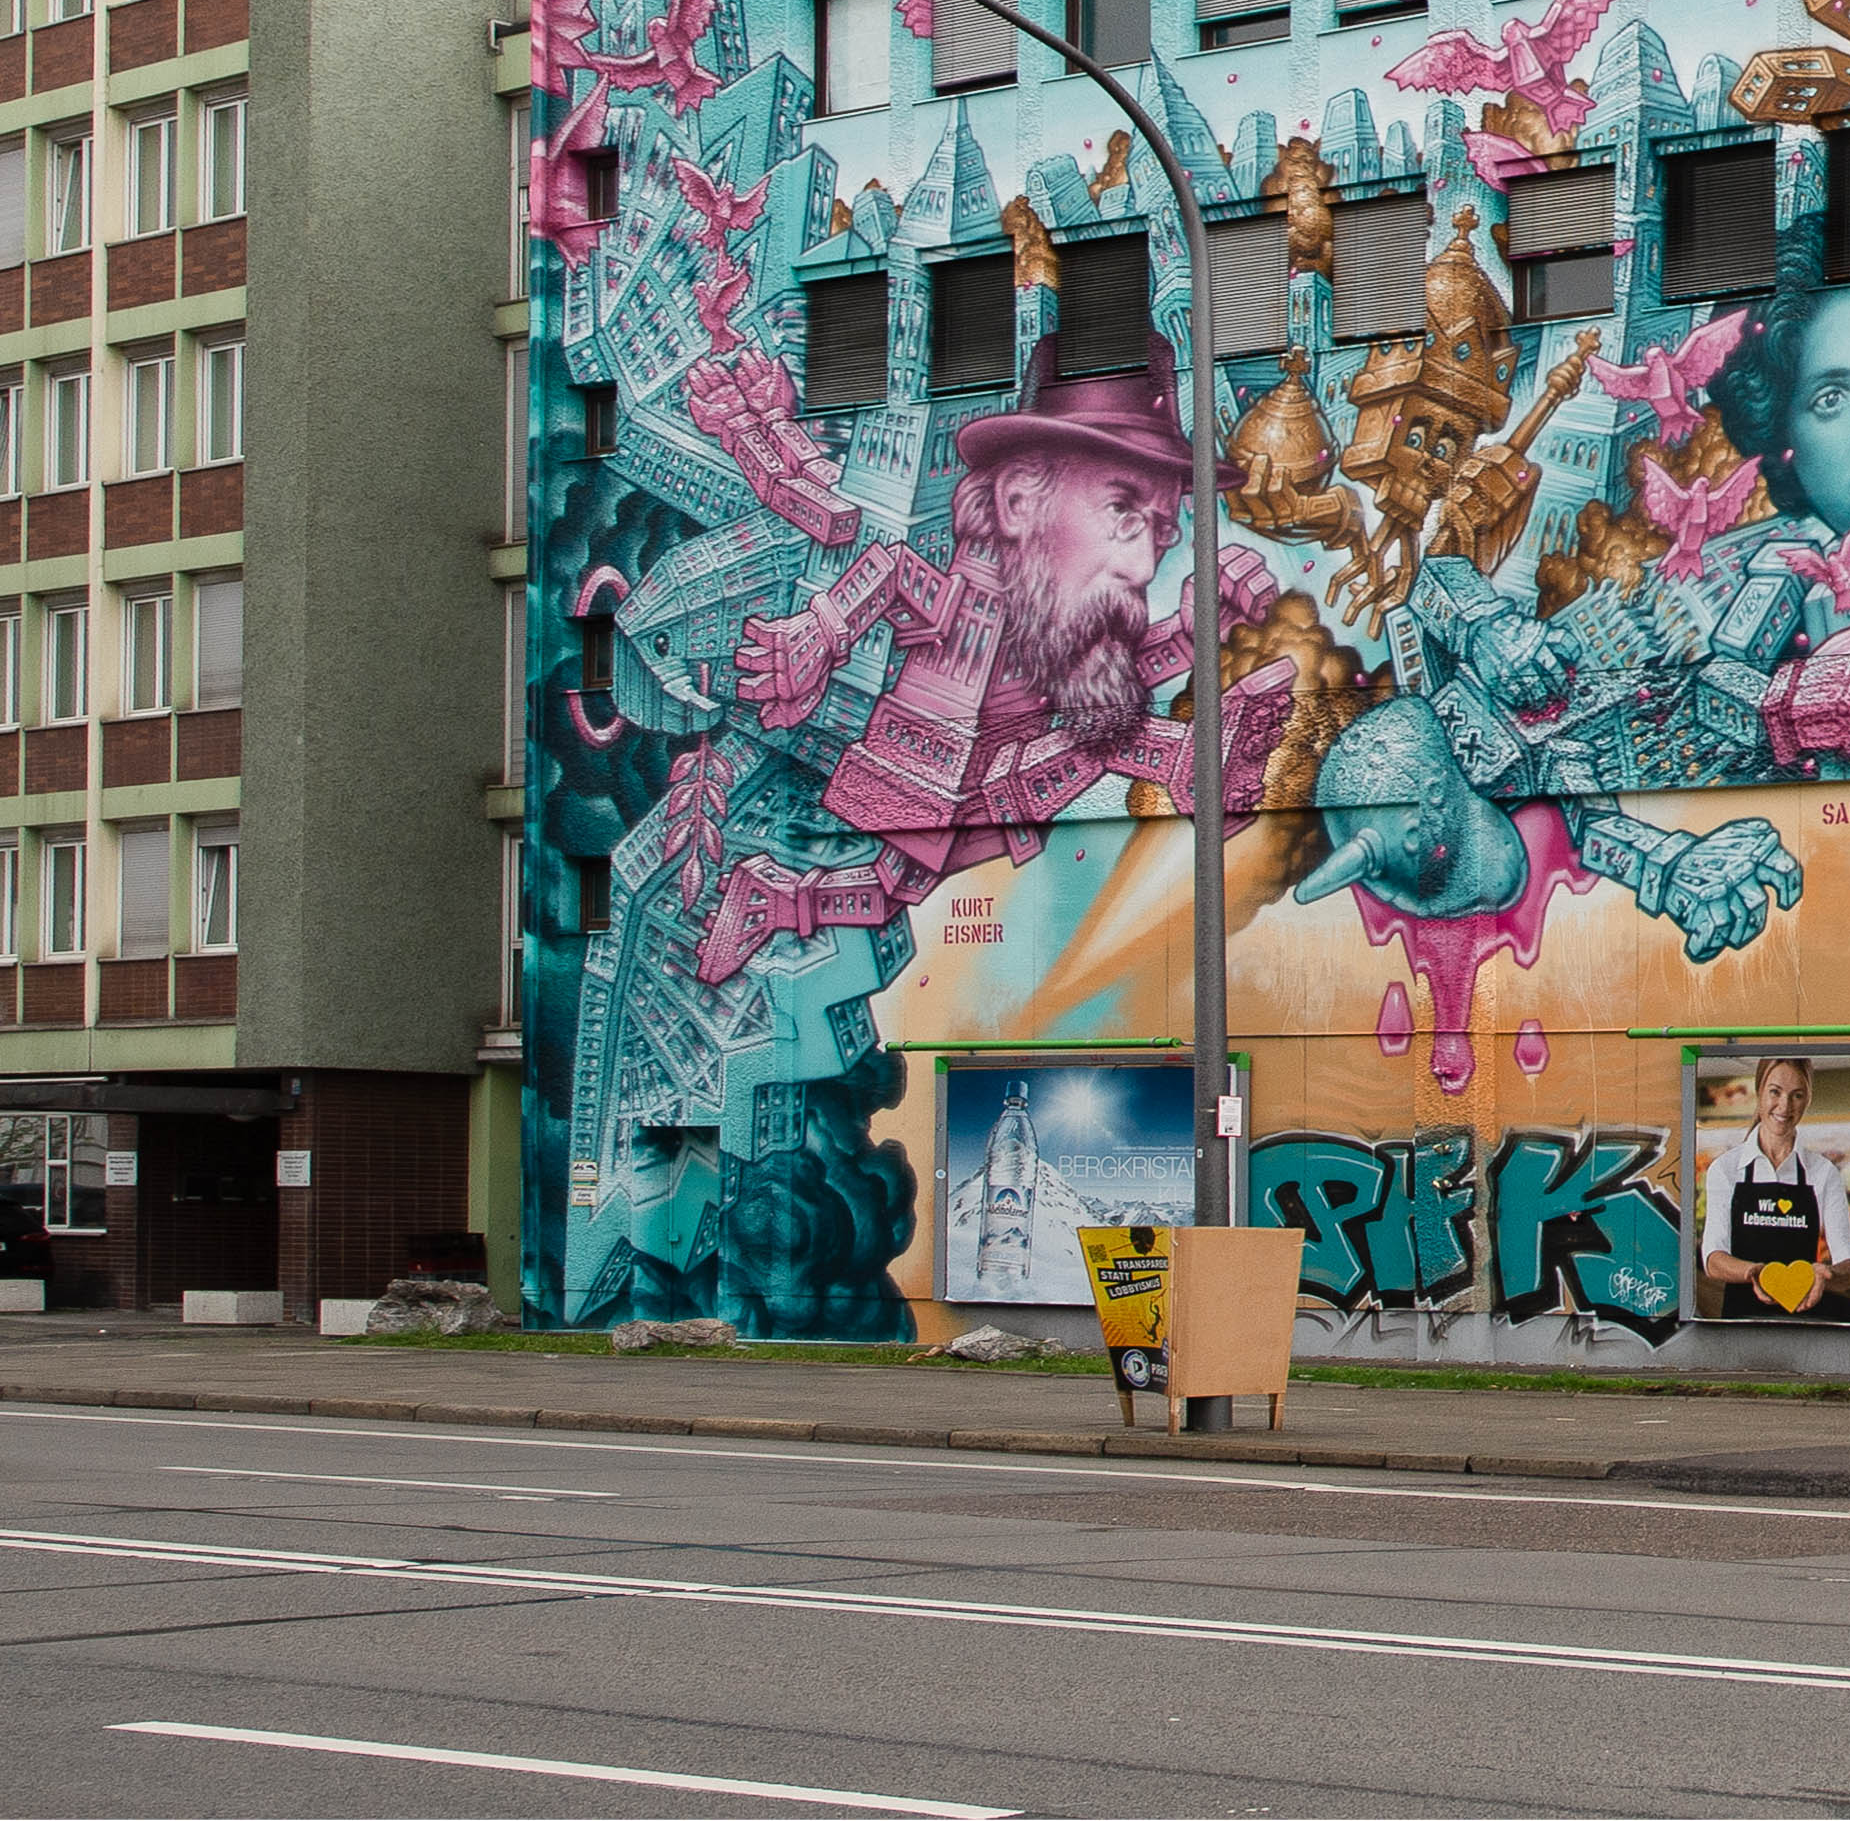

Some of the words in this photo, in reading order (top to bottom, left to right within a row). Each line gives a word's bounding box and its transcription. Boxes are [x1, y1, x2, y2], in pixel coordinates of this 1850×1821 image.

[951, 897, 994, 918] KURT
[944, 923, 1004, 944] EISNER
[1758, 1199, 1776, 1212] Wir
[1743, 1211, 1808, 1229] Lebensmittel.
[1100, 1270, 1131, 1281] STATT
[1108, 1278, 1161, 1298] LOBBYISMUS
